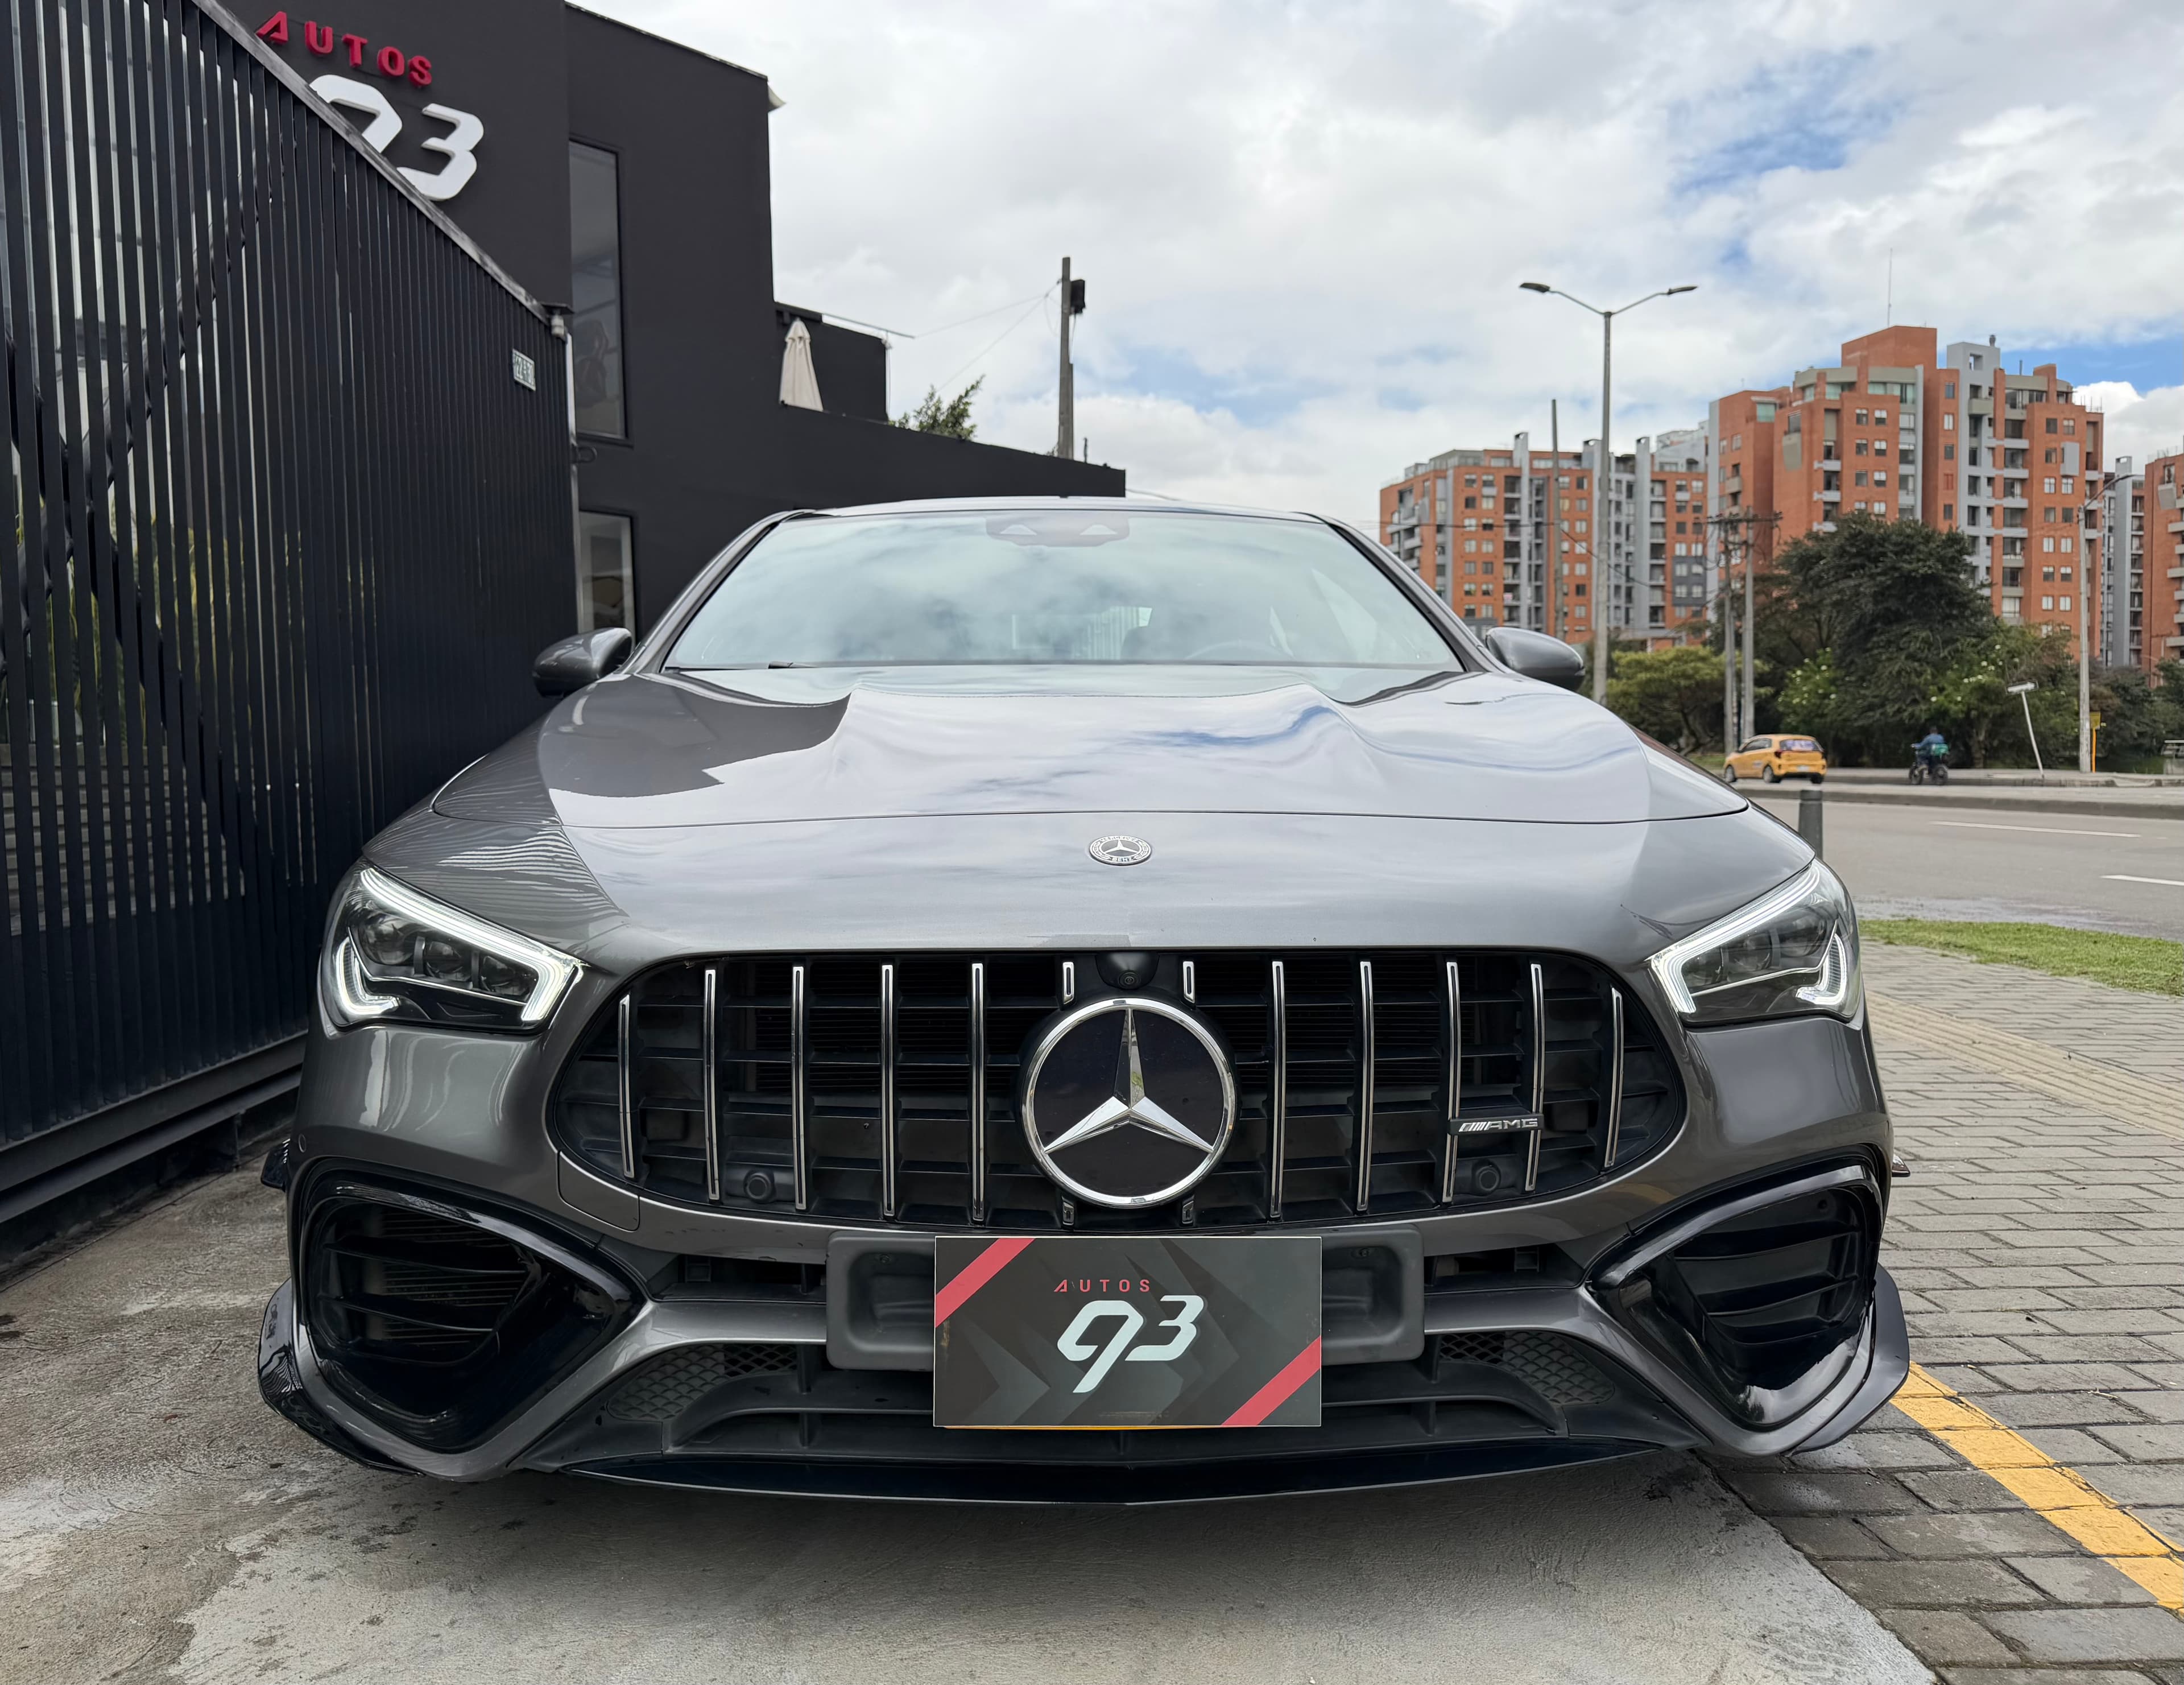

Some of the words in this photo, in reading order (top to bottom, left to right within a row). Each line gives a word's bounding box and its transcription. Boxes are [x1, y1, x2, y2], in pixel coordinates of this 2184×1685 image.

[256, 10, 432, 88] AUTOS
[1053, 1279, 1150, 1293] AUTOS
[1056, 1294, 1205, 1394] 93
